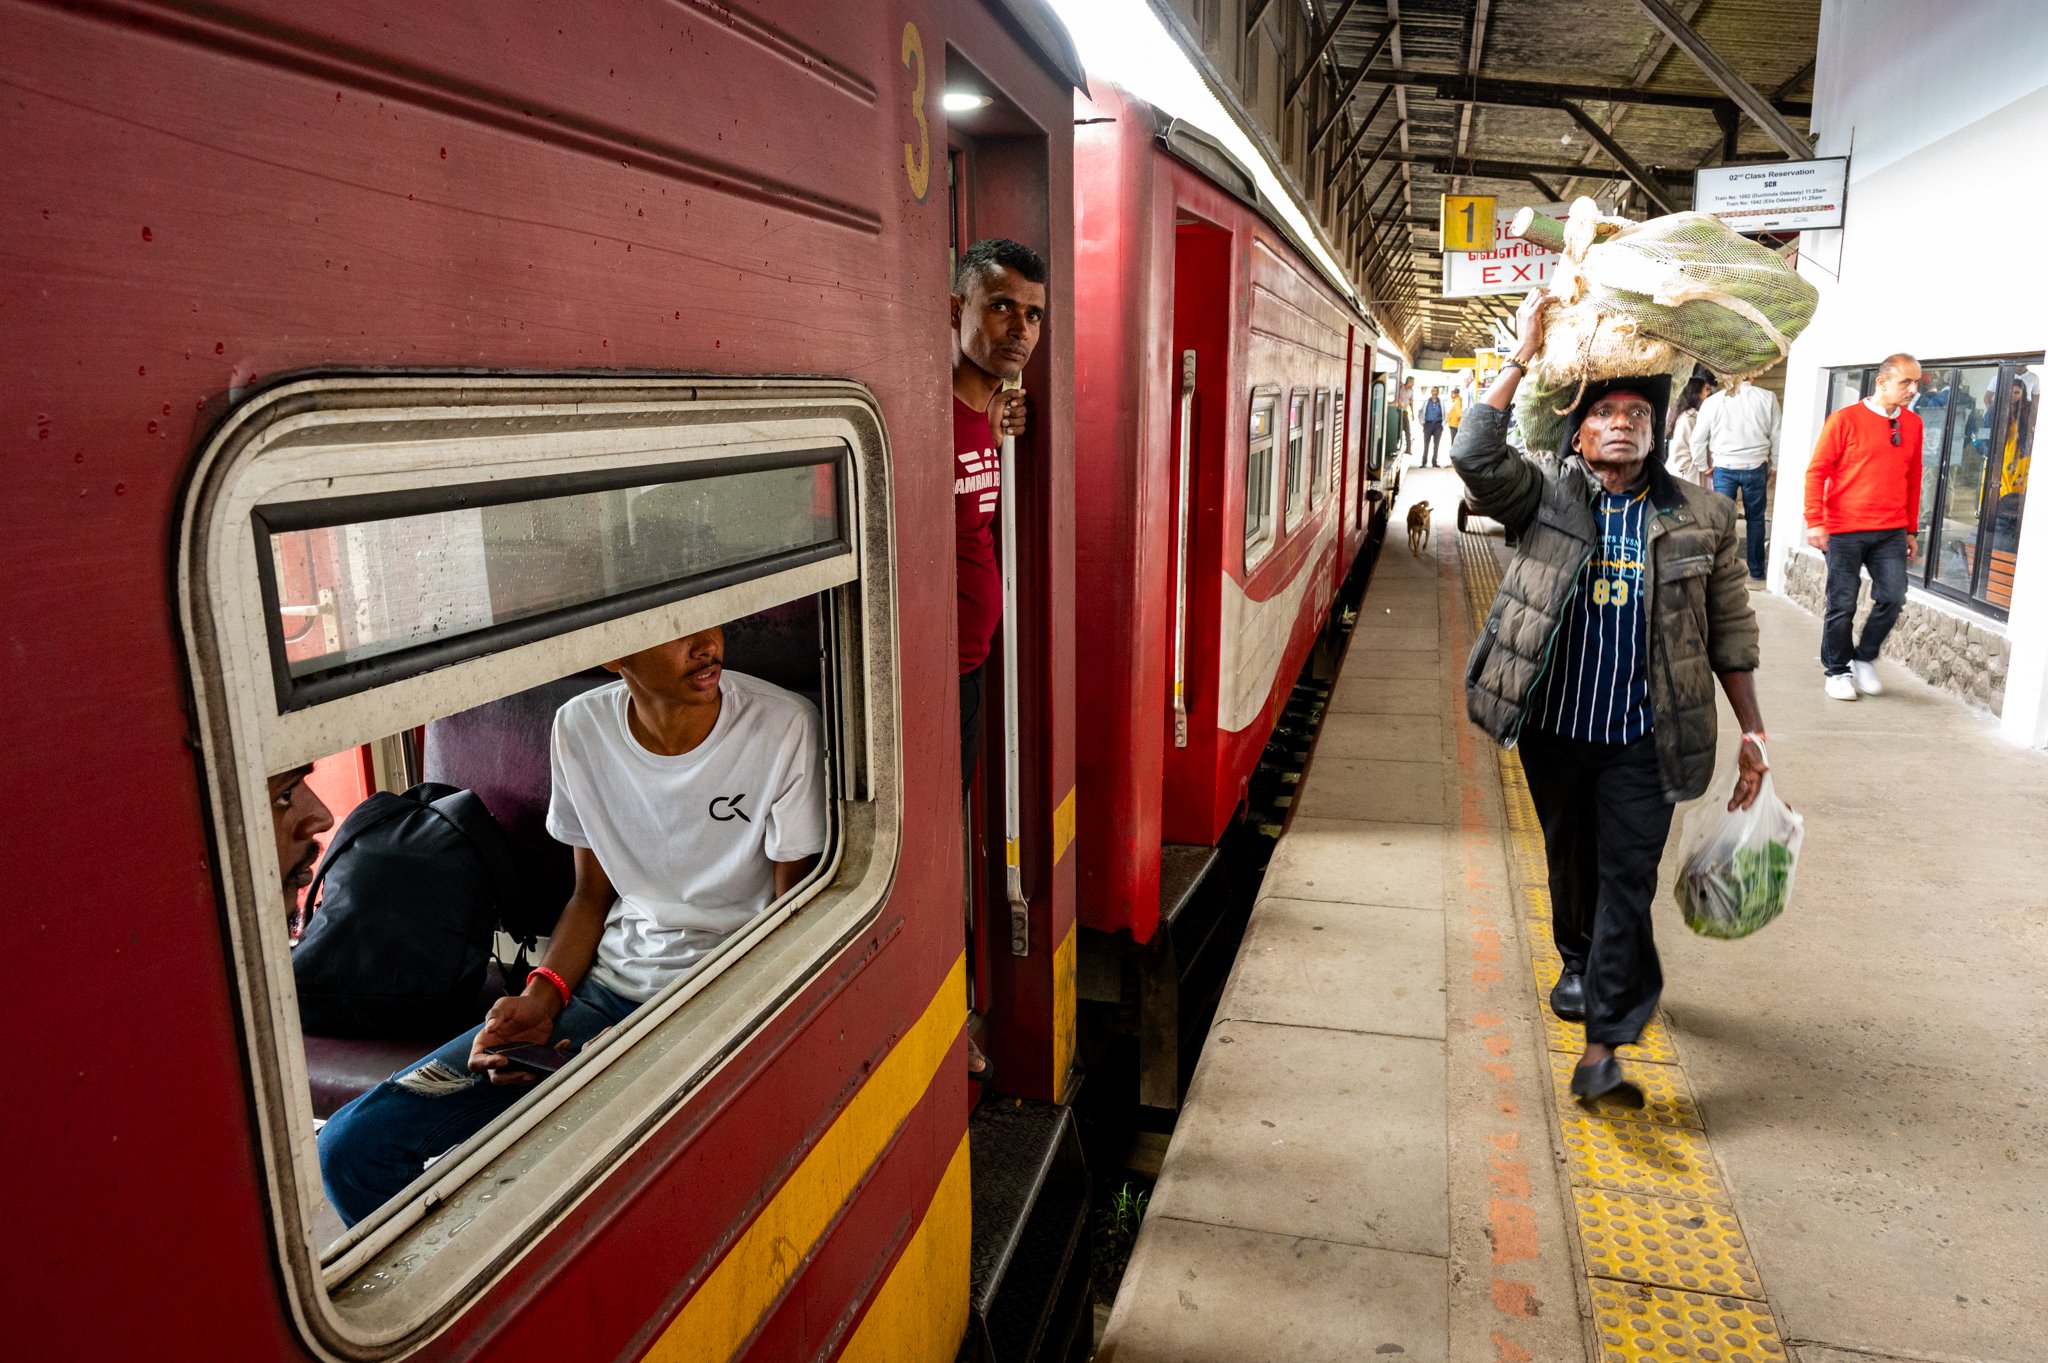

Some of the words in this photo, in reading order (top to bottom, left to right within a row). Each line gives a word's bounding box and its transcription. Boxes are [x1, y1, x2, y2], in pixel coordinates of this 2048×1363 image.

[902, 21, 930, 202] 3
[1768, 169, 1815, 178] Reservation
[1460, 202, 1475, 243] 1
[1483, 260, 1559, 284] EXI
[1593, 579, 1628, 606] 83
[709, 794, 751, 823] CK
